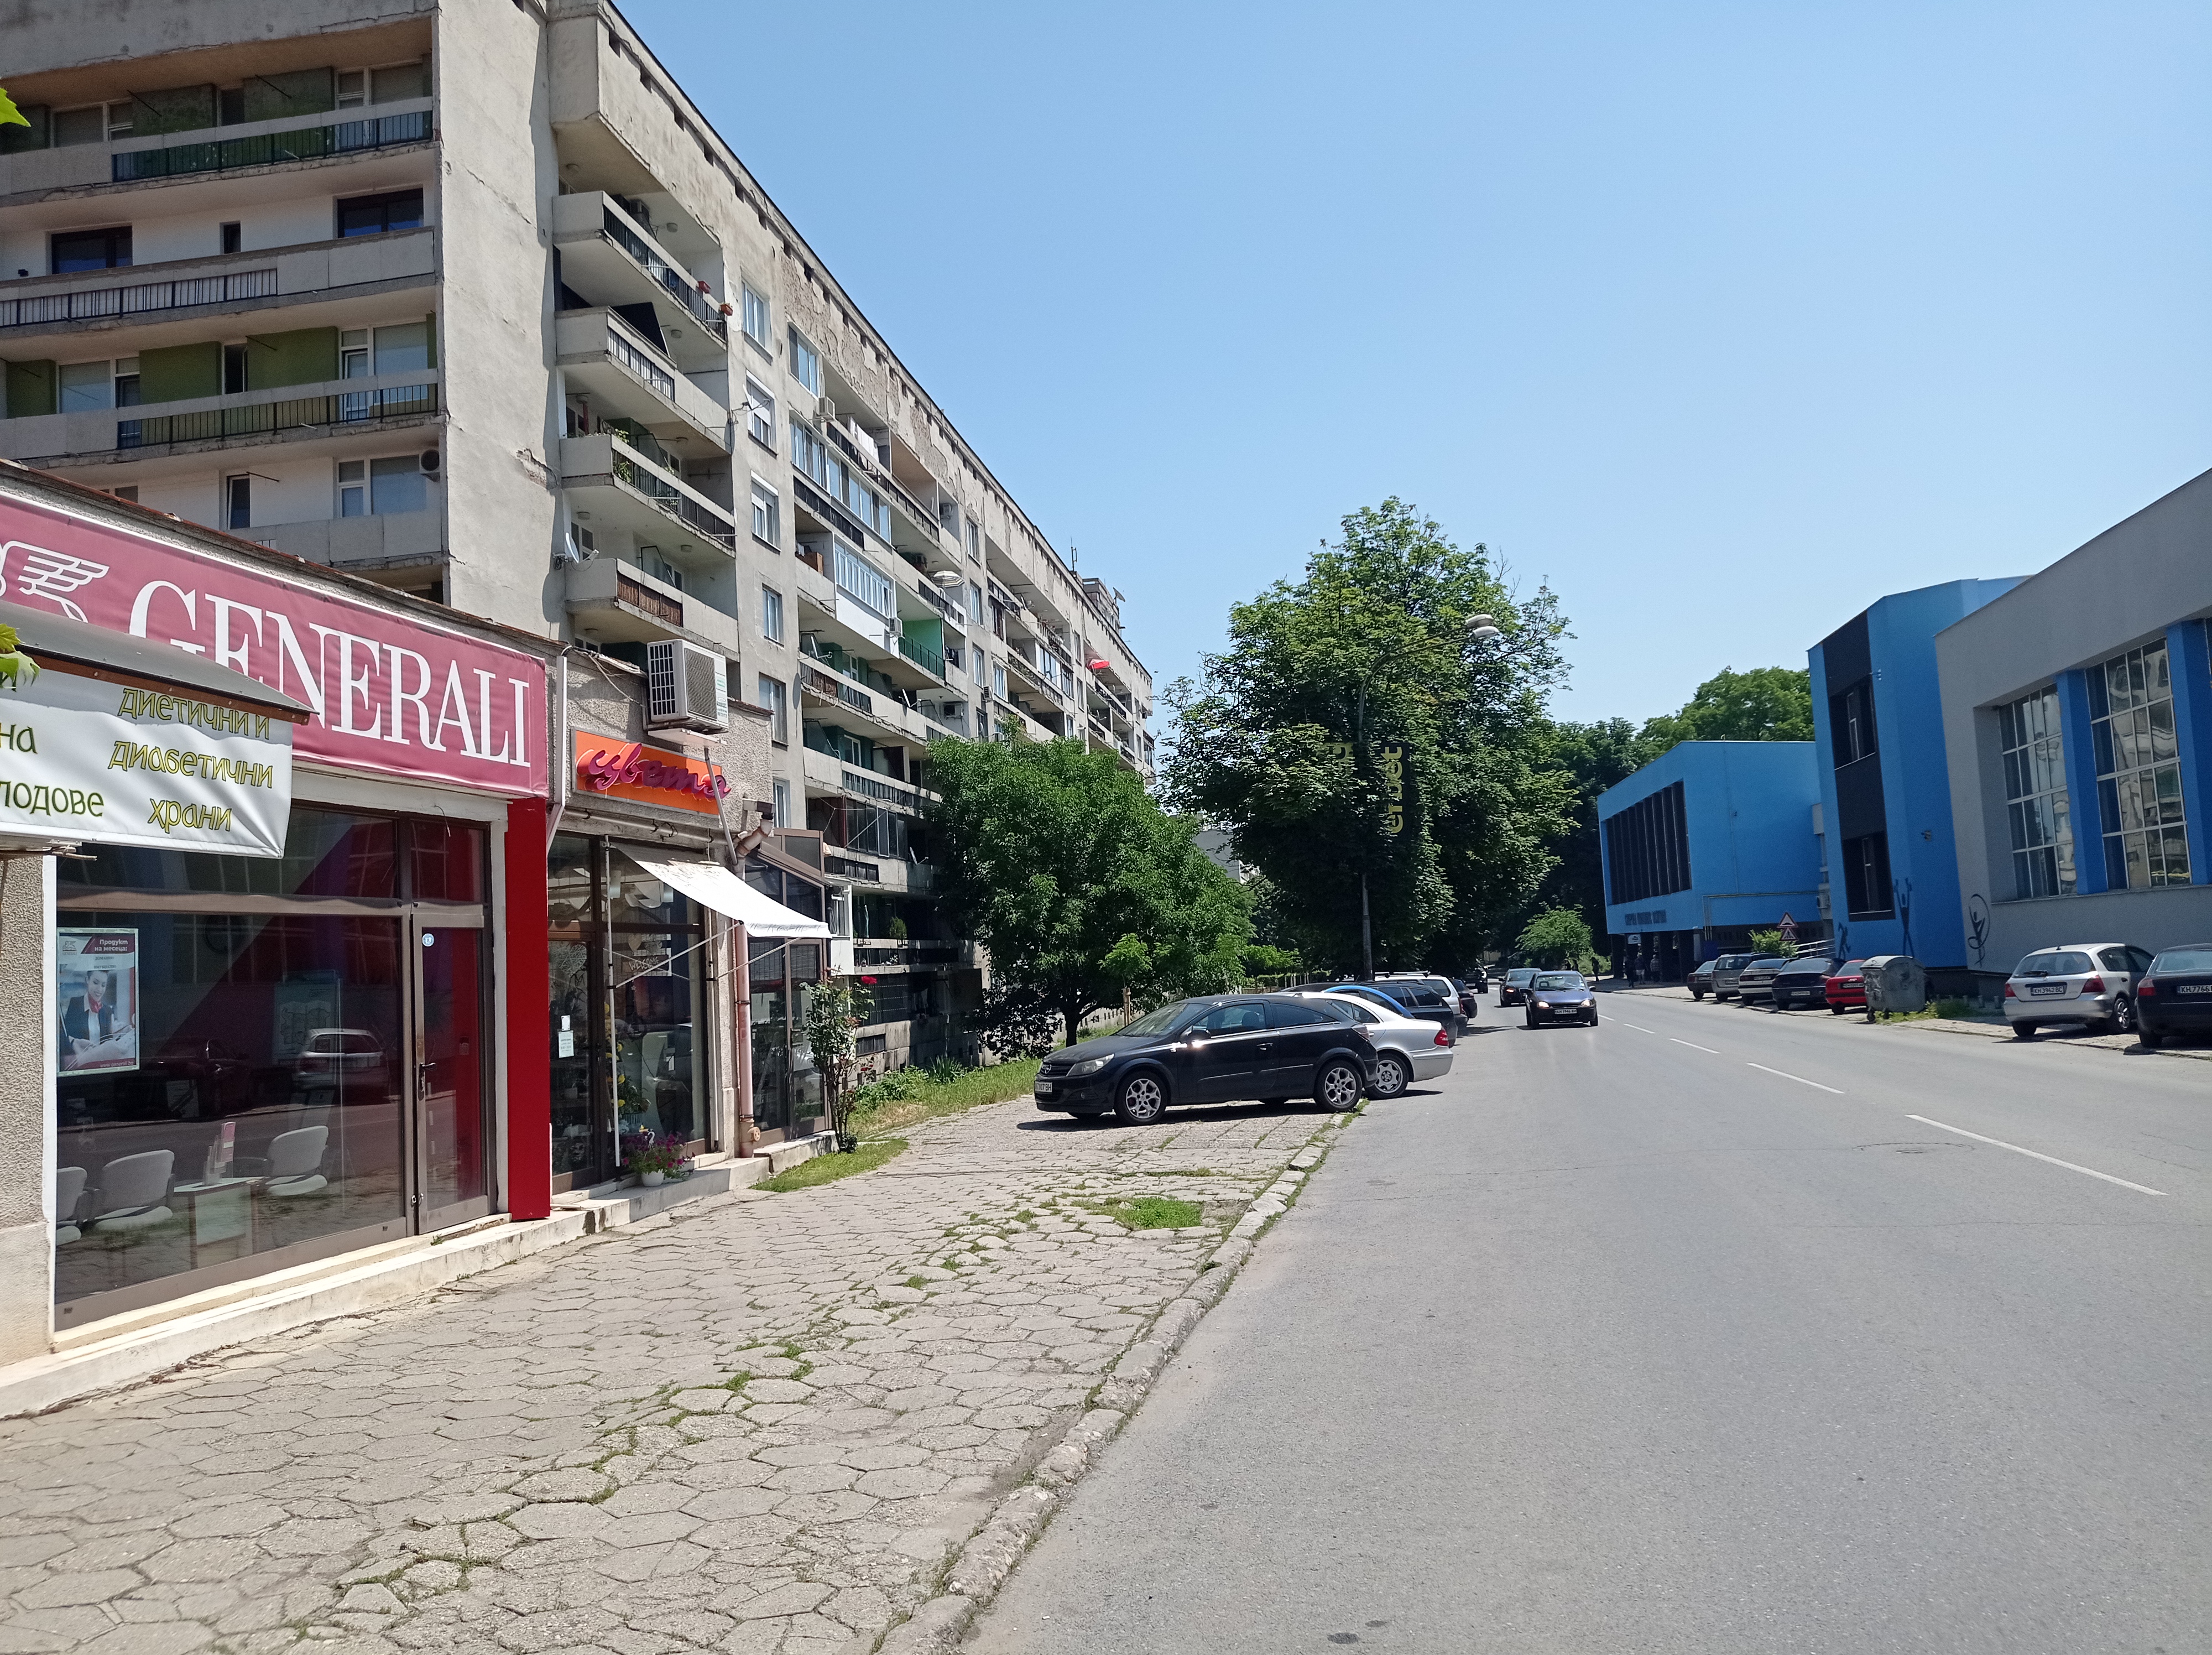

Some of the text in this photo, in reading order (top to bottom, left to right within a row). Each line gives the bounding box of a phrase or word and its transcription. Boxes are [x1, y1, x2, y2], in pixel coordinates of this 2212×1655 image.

[129, 580, 531, 768] GENERALI
[117, 688, 269, 740] диетични и
[107, 740, 273, 789] диабетични
[147, 798, 232, 834] храни
